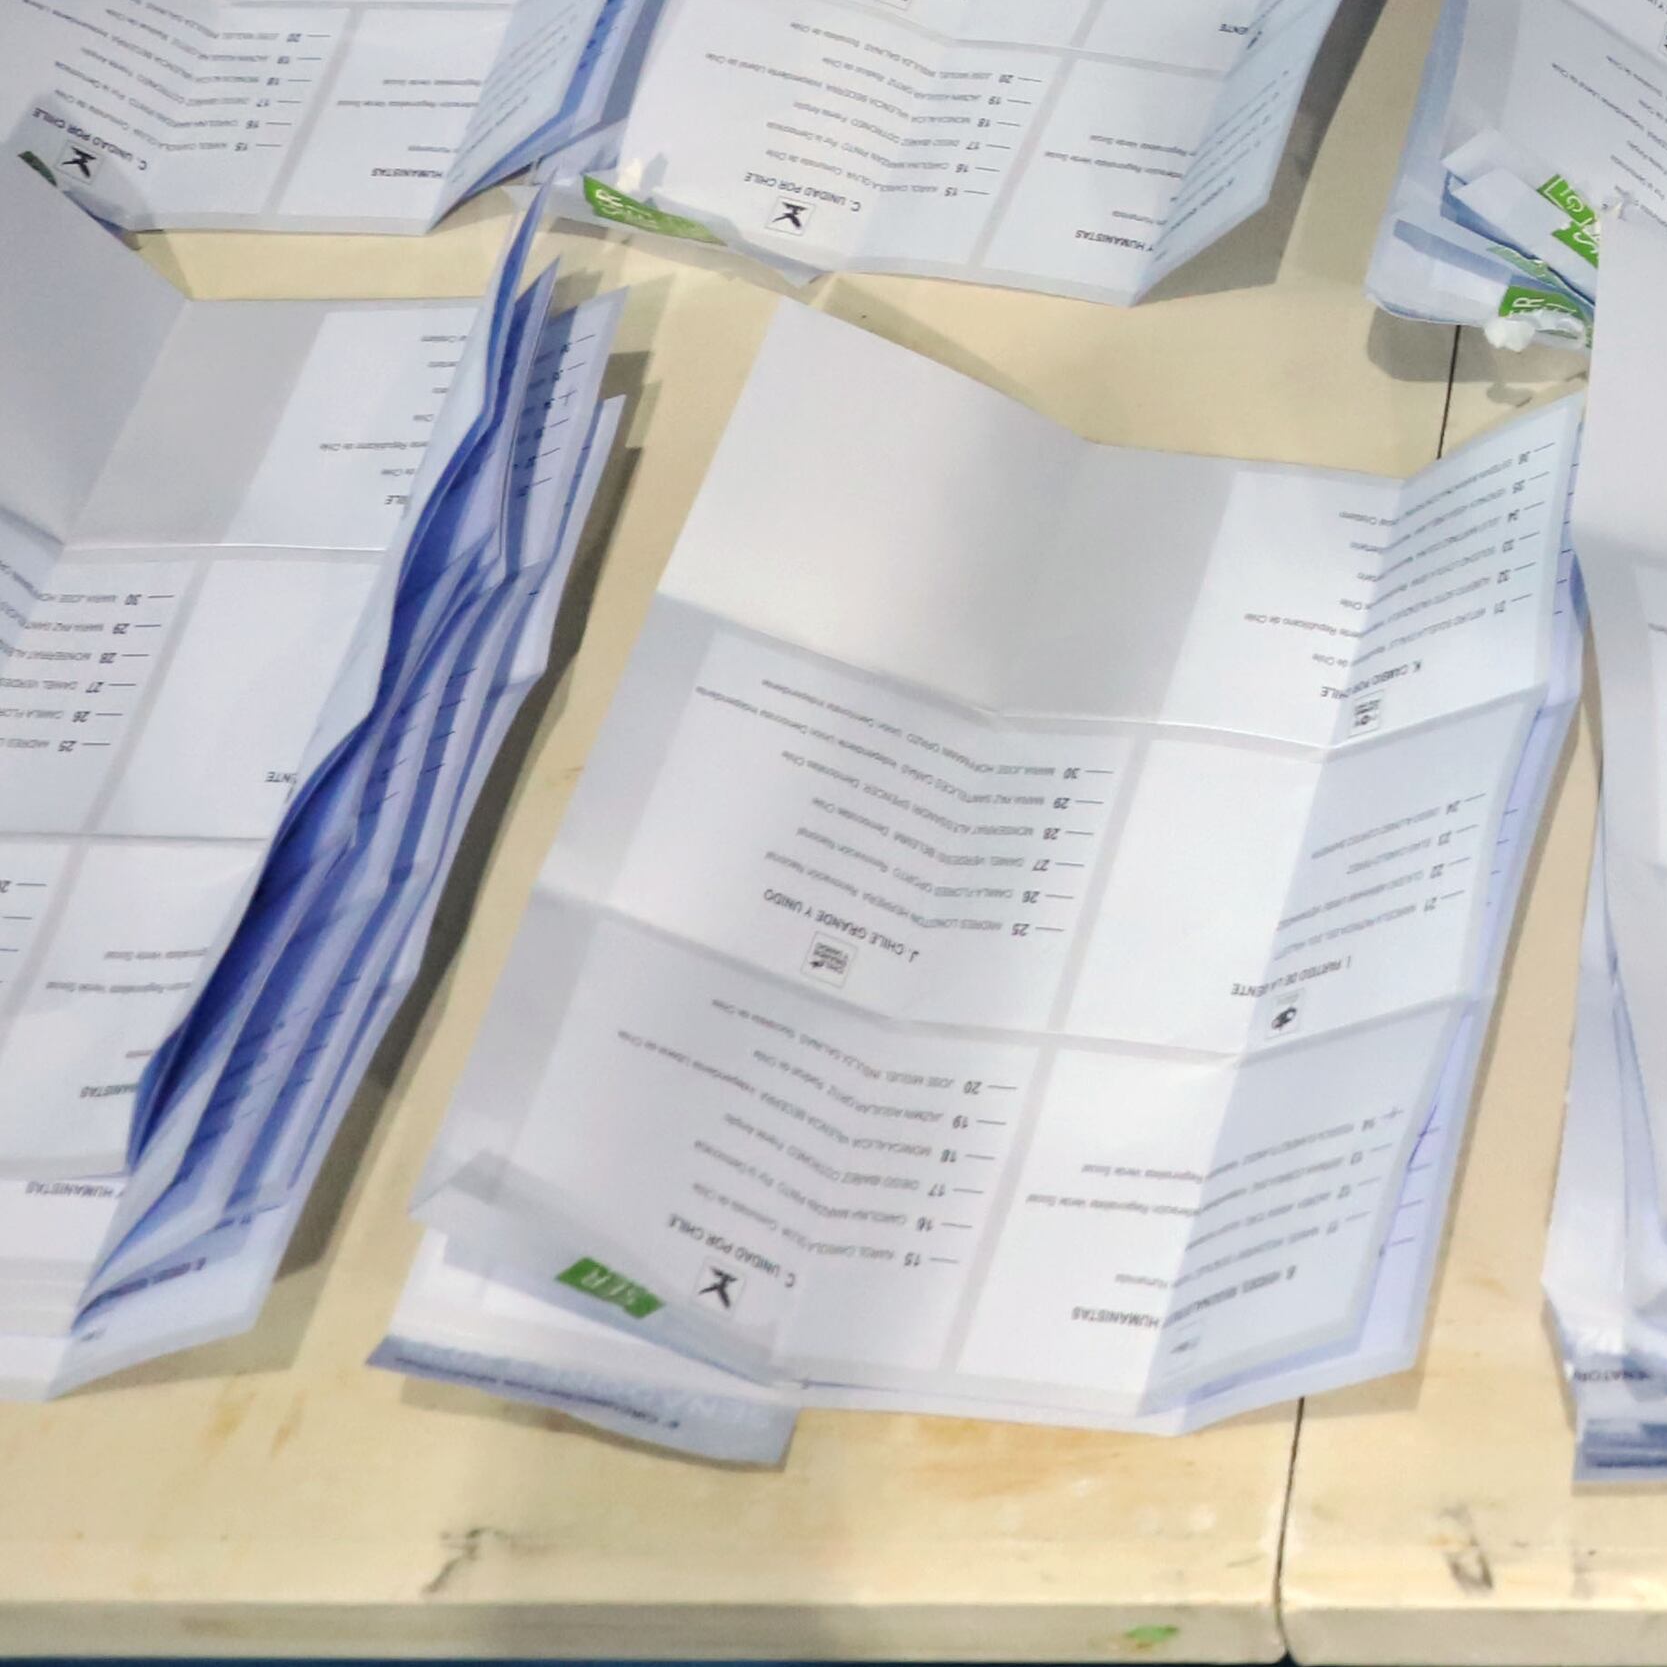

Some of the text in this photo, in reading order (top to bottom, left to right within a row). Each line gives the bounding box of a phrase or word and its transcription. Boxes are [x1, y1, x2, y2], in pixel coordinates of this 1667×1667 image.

[32, 107, 133, 162] UNIDAD POR CHILE
[744, 173, 777, 188] CHILE
[779, 180, 802, 196] POR
[804, 186, 846, 207] UNIDAD
[1075, 230, 1145, 250] HUMANISTAS
[1033, 859, 1049, 871] 27
[763, 889, 803, 916] UNIDO
[1023, 890, 1040, 904] 26
[815, 909, 866, 940] GRANDE
[1013, 923, 1029, 937] 25
[869, 931, 904, 957] CHILE
[667, 1214, 705, 1243] CHILE
[706, 1235, 732, 1254] POR
[1072, 1306, 1159, 1328] HUMANISTAS
